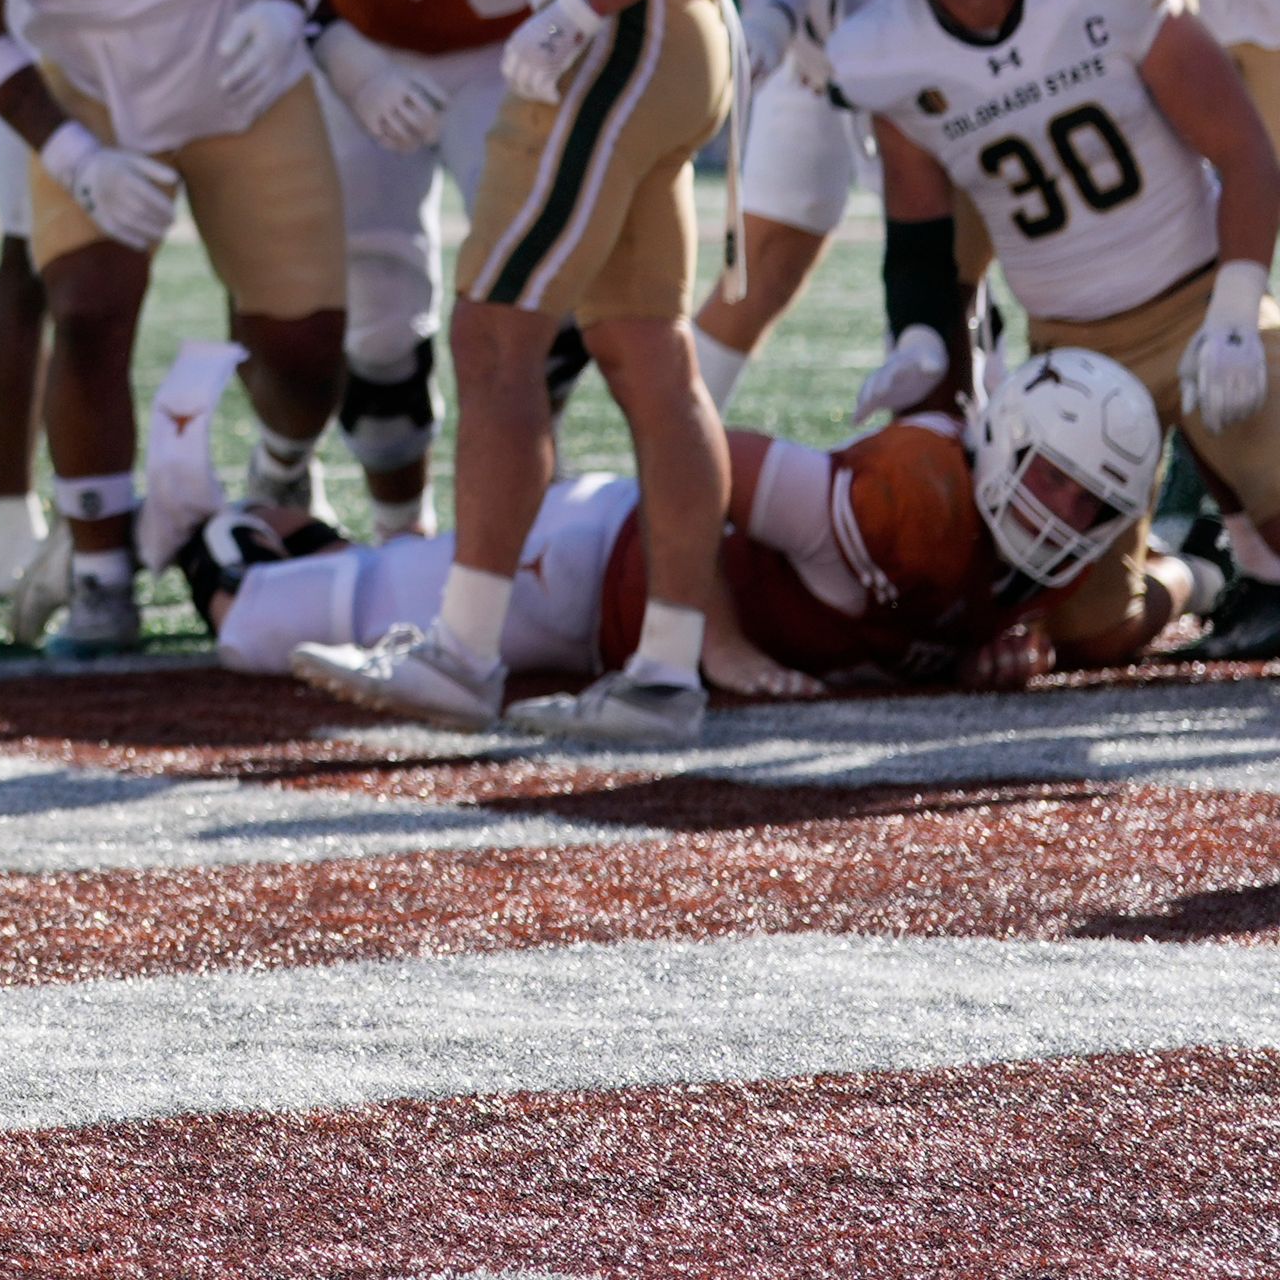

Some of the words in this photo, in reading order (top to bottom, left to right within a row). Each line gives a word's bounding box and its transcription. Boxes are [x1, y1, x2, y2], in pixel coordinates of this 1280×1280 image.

[1083, 15, 1110, 49] C
[942, 80, 1043, 142] COLORADO
[1044, 54, 1106, 97] STATE
[978, 98, 1144, 242] 30
